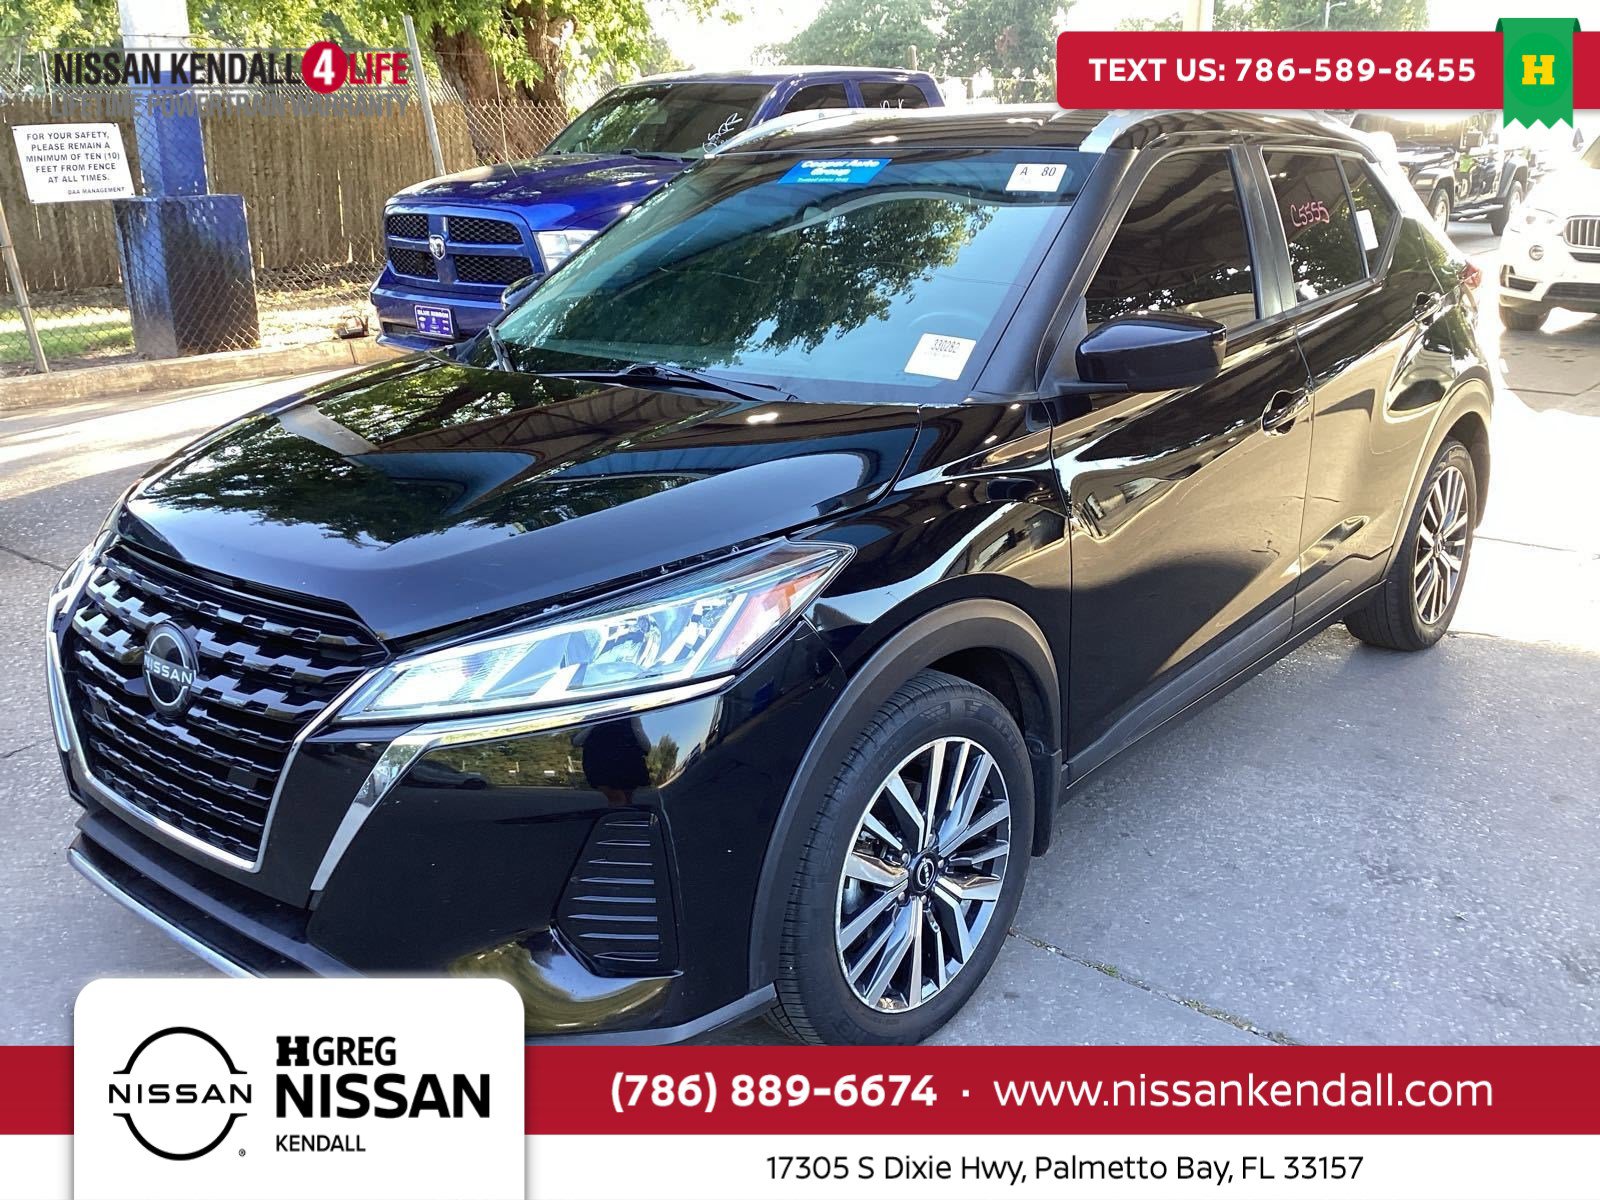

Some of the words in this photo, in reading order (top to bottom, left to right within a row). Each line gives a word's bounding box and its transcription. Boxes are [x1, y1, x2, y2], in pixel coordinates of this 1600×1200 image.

[26, 133, 45, 141] FOR
[48, 131, 72, 140] YOUR
[75, 131, 110, 139] SAFETY,
[31, 143, 65, 152] PLEASE
[68, 142, 102, 150] REMAIN
[104, 141, 111, 149] A
[26, 154, 68, 162] MINIMUM
[84, 152, 102, 160] TEN
[104, 151, 120, 160] (10)
[36, 165, 58, 173] FEET
[61, 164, 86, 172] FROM
[88, 162, 116, 170] FENCE
[1041, 166, 1057, 177] 80
[48, 175, 59, 184] AT
[62, 174, 78, 182] ALL
[81, 173, 110, 181] TIMES.
[82, 186, 125, 194] MANAGEMENT
[144, 654, 193, 685] NISSAN
